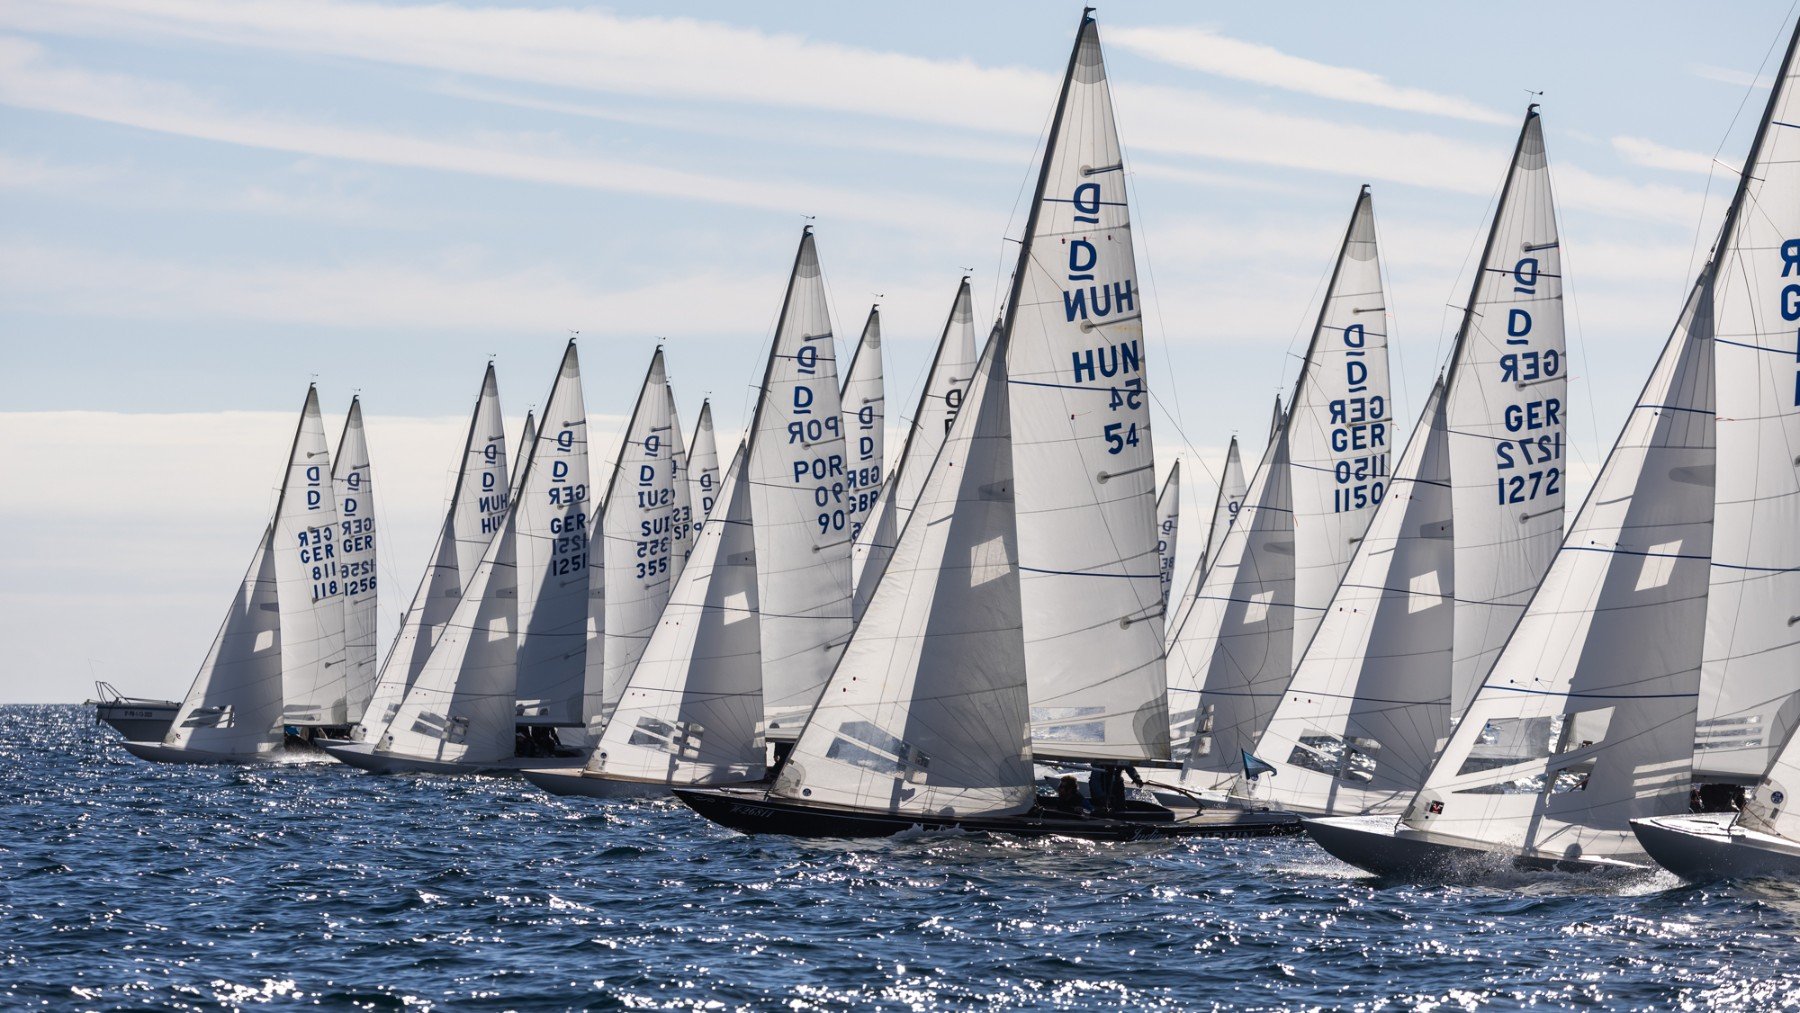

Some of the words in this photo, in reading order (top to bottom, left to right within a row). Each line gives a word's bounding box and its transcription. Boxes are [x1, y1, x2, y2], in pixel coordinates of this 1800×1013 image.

[1070, 240, 1096, 271] D
[1508, 309, 1531, 337] D
[1073, 340, 1139, 383] HUN
[1347, 362, 1367, 385] D
[794, 386, 813, 408] D
[1505, 398, 1560, 432] GER
[860, 437, 873, 455] D
[1104, 423, 1139, 454] 54
[1332, 424, 1384, 452] GER
[553, 461, 568, 478] D
[640, 465, 654, 481] D
[794, 455, 843, 482] POR
[483, 472, 494, 487] D
[1499, 468, 1559, 505] 1272
[308, 491, 320, 505] D
[345, 498, 357, 512] D
[849, 491, 878, 514] GBR
[1335, 482, 1383, 512] 1150
[482, 515, 504, 534] HU
[551, 514, 585, 534] GER
[641, 517, 669, 536] SUI
[674, 524, 690, 540] SP
[818, 510, 844, 534] 90
[301, 544, 334, 563] GER
[344, 536, 372, 552] GER
[553, 553, 586, 576] 1251
[636, 557, 667, 579] 355
[344, 577, 376, 596] 1256
[1160, 572, 1170, 583] EL
[314, 581, 337, 598] 118
